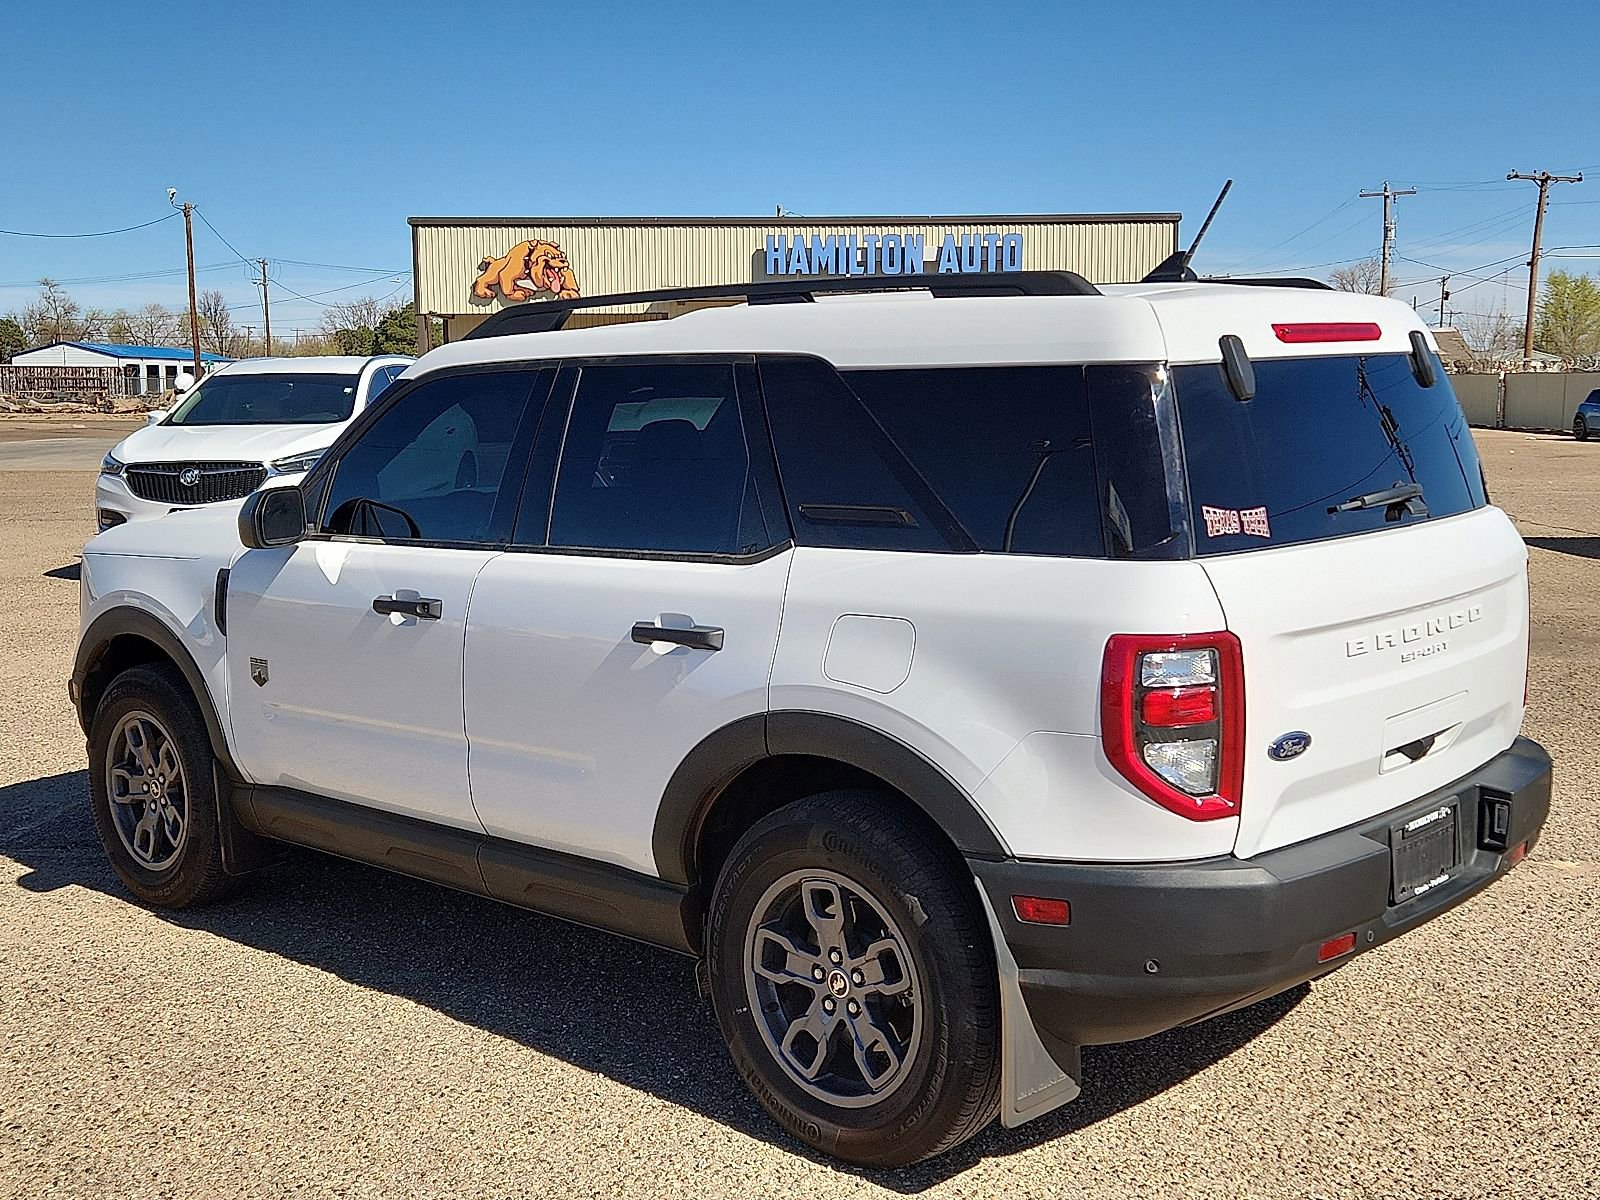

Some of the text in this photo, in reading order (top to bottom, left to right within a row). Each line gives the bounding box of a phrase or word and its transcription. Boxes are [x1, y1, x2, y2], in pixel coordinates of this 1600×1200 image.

[765, 233, 1023, 275] HAMILTON AUTO
[1201, 505, 1272, 538] TEXAS TECH
[1345, 604, 1483, 658] BRONCO
[1401, 640, 1449, 663] SPORT
[1278, 738, 1306, 758] Ford
